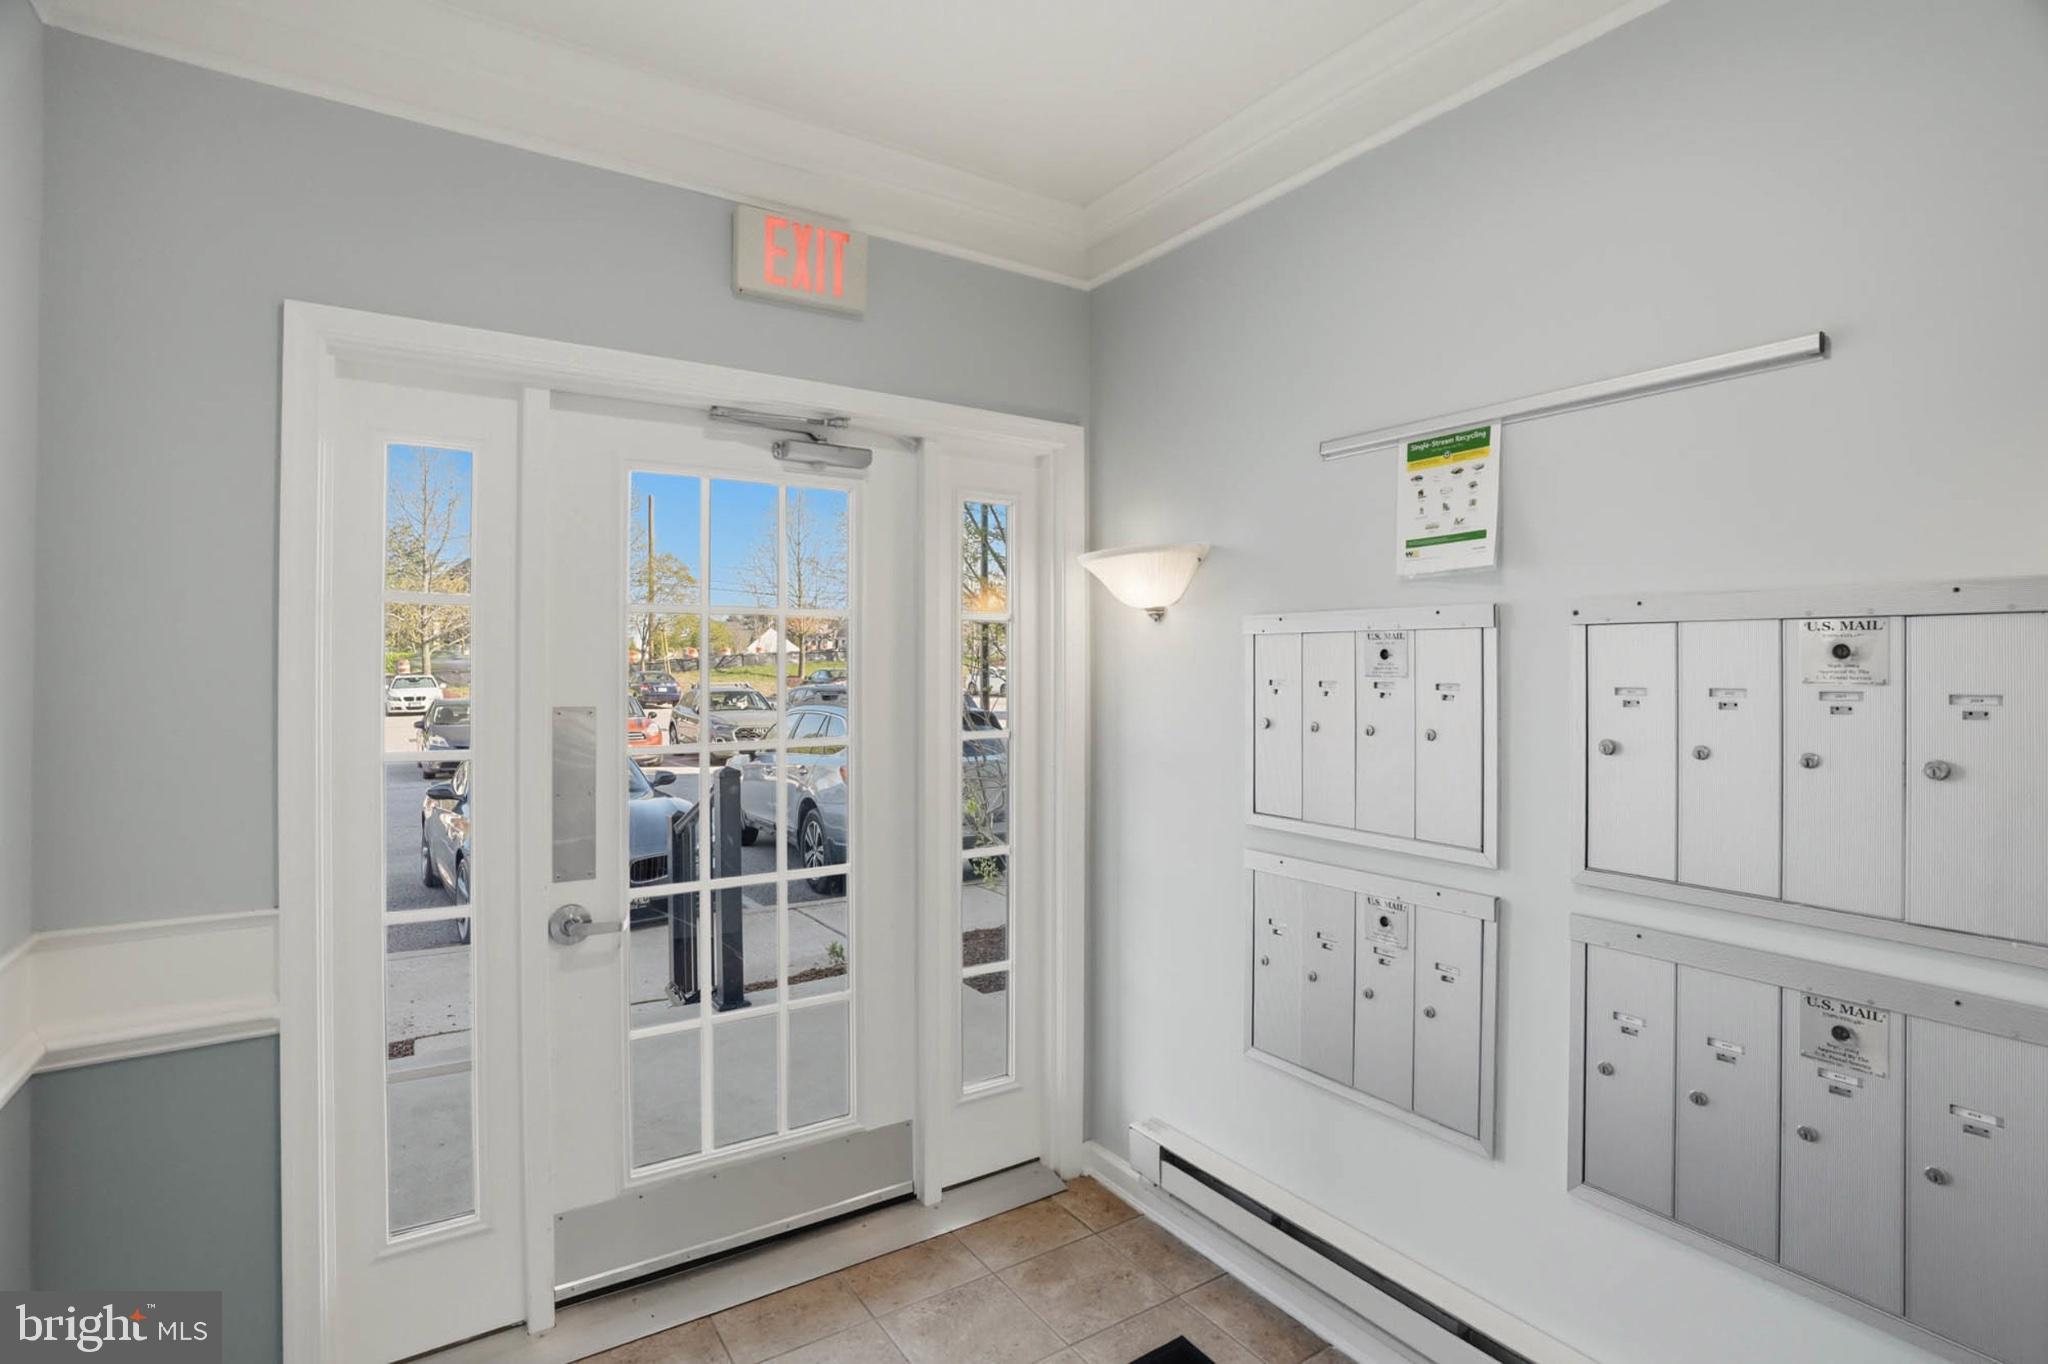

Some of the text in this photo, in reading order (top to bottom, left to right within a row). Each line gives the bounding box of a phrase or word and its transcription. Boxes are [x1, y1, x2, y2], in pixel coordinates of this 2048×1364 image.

[764, 216, 850, 298] EXIT
[1410, 437, 1454, 452] Single-Stream
[1455, 431, 1487, 443] Recycling
[1806, 620, 1883, 631] U.S. MAIL
[1383, 631, 1405, 640] MAIL
[1383, 900, 1406, 912] MAIL
[1806, 995, 1834, 1011] U.S.
[1839, 1003, 1883, 1023] MAIL
